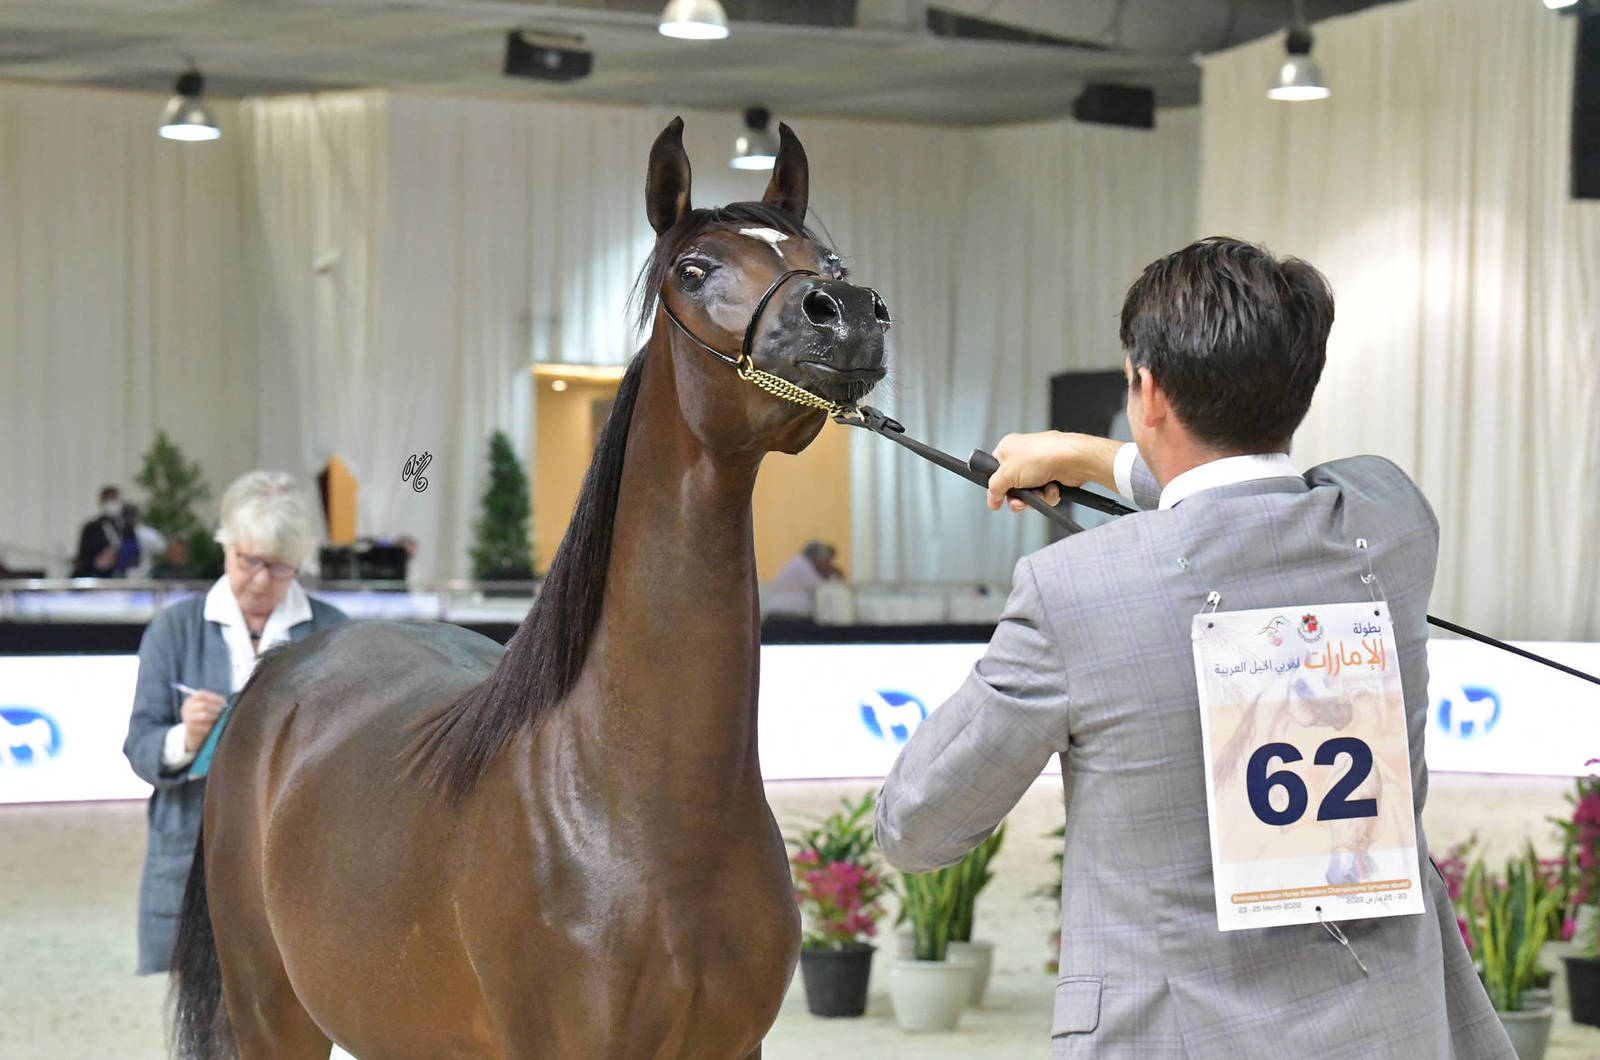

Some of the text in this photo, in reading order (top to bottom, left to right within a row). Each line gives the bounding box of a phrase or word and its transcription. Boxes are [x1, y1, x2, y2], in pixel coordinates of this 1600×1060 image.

[1353, 622, 1381, 637] بطولة
[1304, 638, 1385, 677] الإمارات
[1215, 661, 1246, 676] العربية
[1246, 737, 1378, 825] 62
[1262, 904, 1282, 912] March
